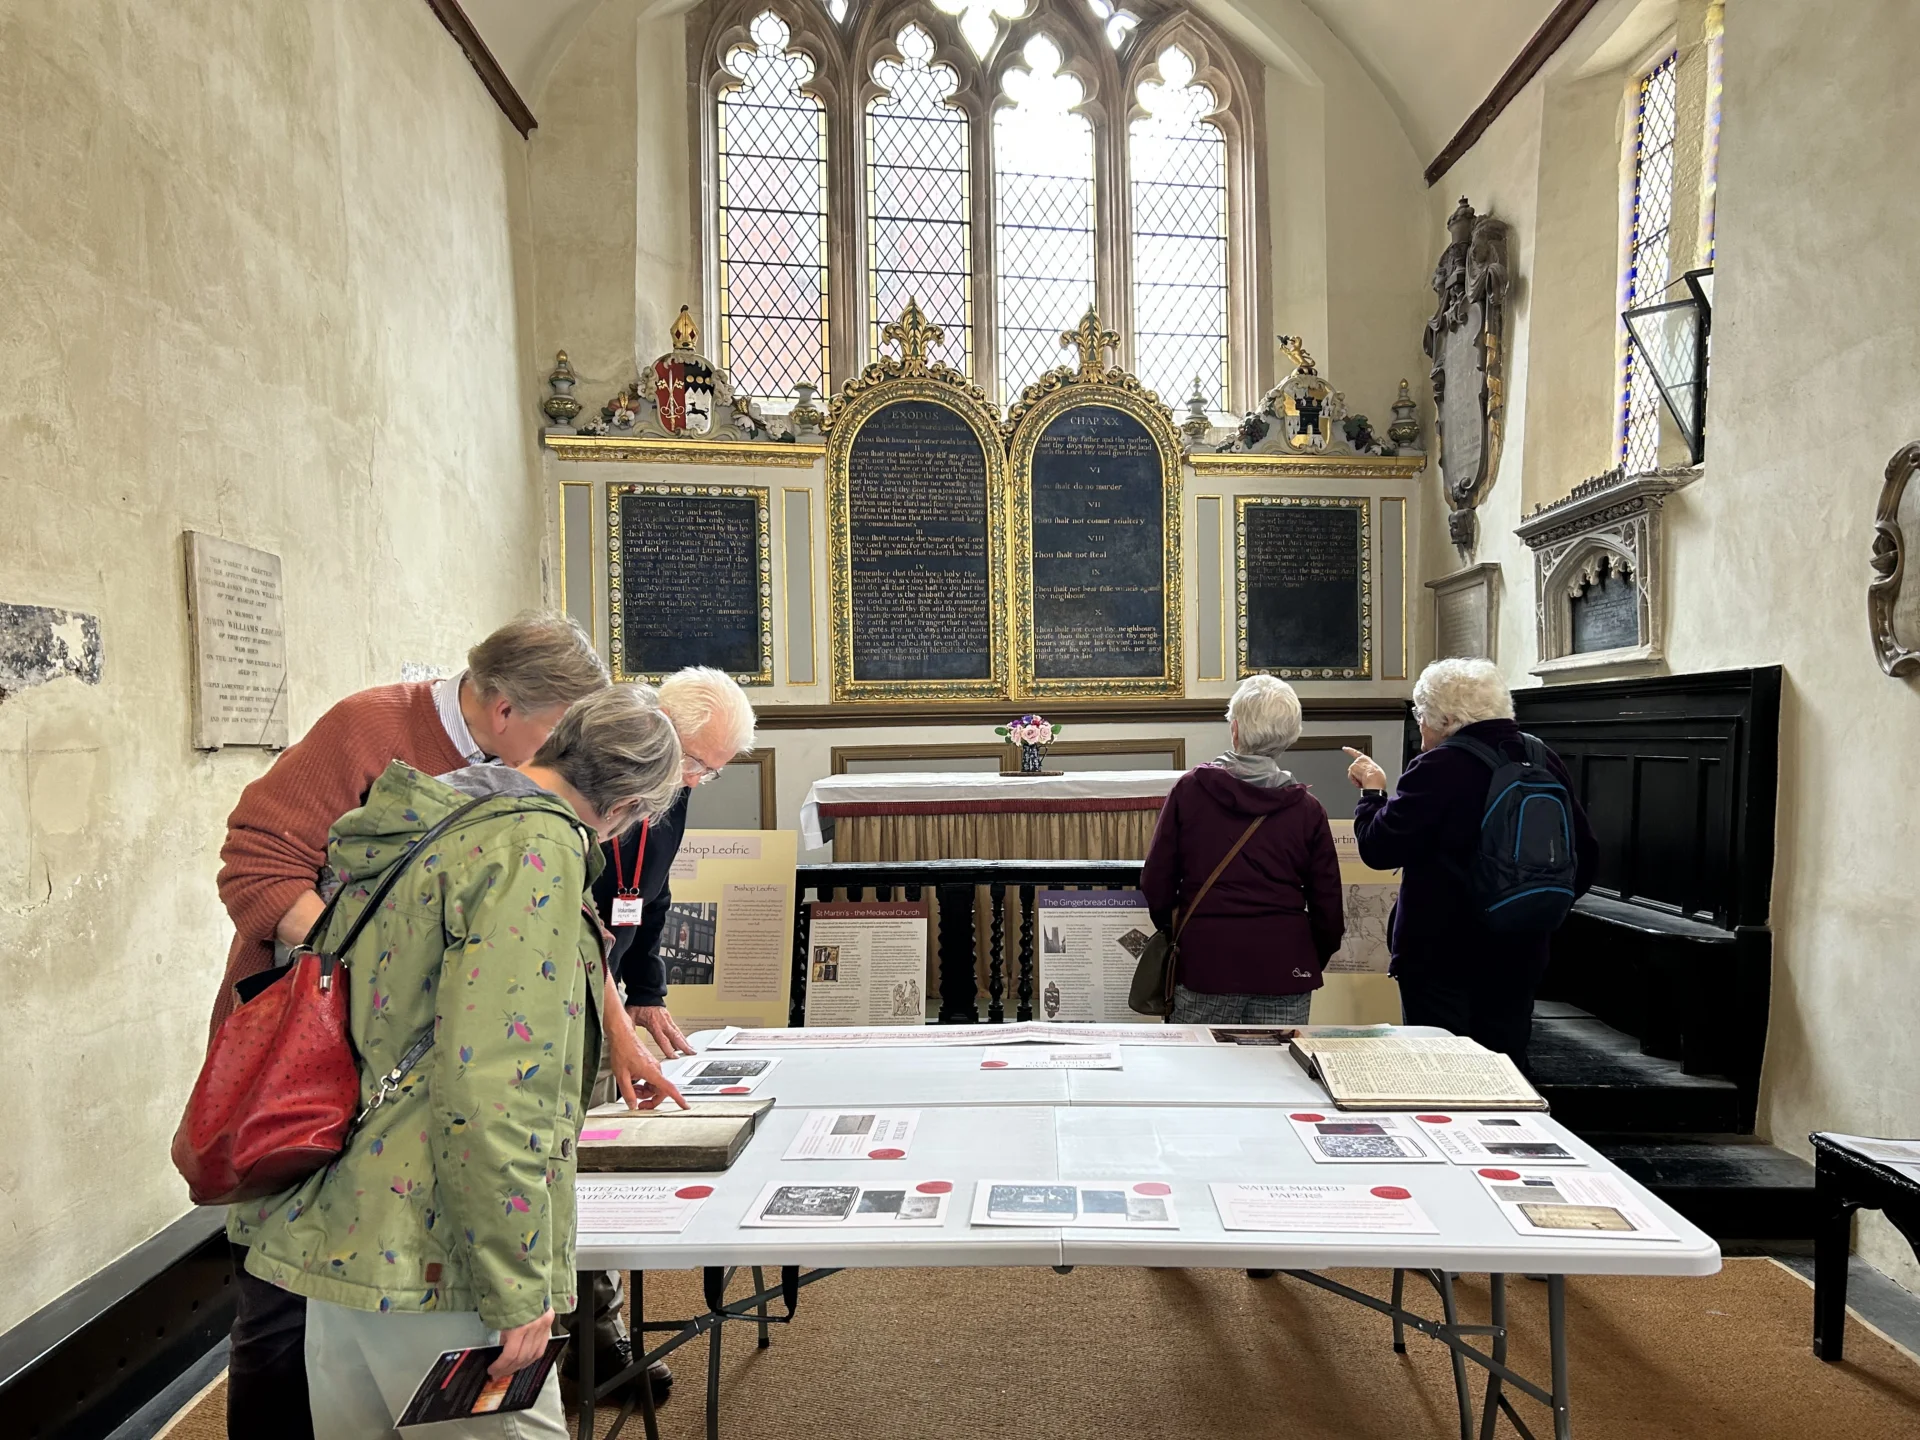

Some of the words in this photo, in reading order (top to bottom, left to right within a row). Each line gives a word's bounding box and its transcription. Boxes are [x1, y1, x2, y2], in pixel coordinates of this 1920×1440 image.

[892, 411, 939, 420] EXODUS
[1071, 417, 1099, 425] CHAP
[228, 621, 258, 632] WILLIAMS
[1334, 834, 1355, 843] artin
[713, 842, 750, 854] Leofric
[734, 885, 756, 893] Bishop
[1060, 899, 1106, 907] Gingerbread
